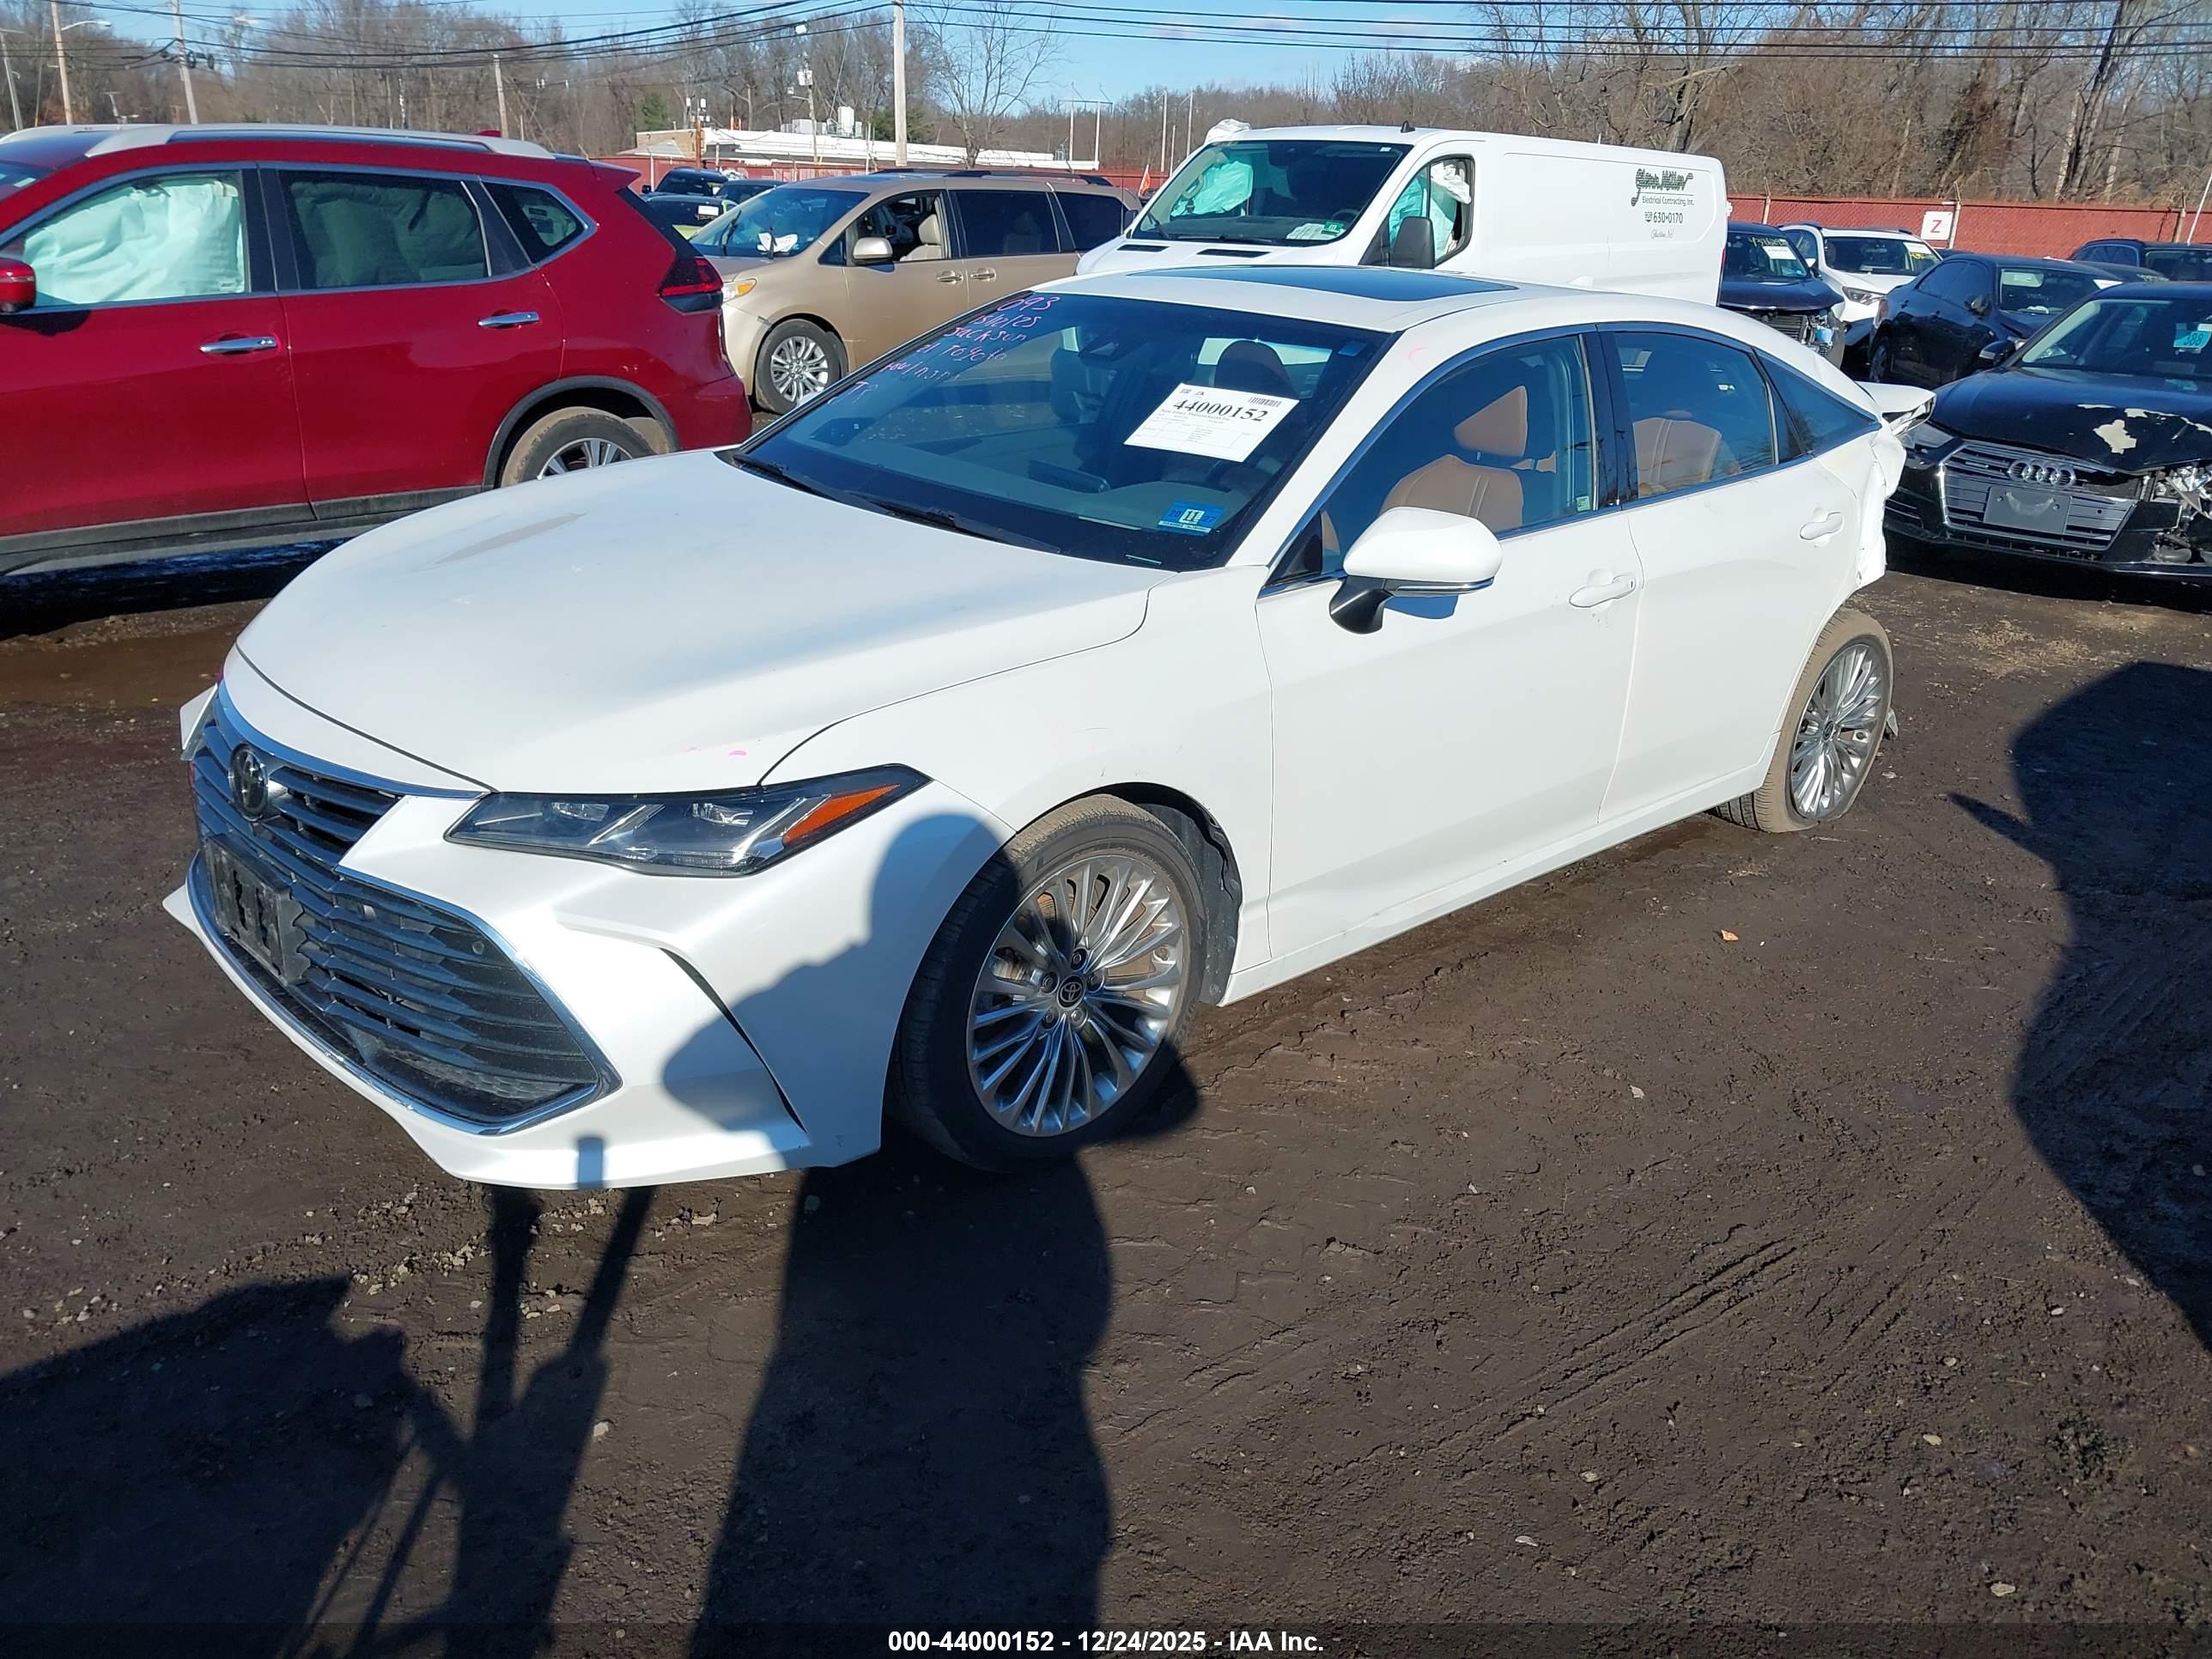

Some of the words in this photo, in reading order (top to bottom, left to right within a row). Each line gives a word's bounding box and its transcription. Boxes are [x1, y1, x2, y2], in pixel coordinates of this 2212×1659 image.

[1642, 196, 1662, 204] Electrical
[1929, 219, 1942, 233] Z
[1173, 399, 1269, 422] 44000152
[1182, 510, 1200, 521] 11
